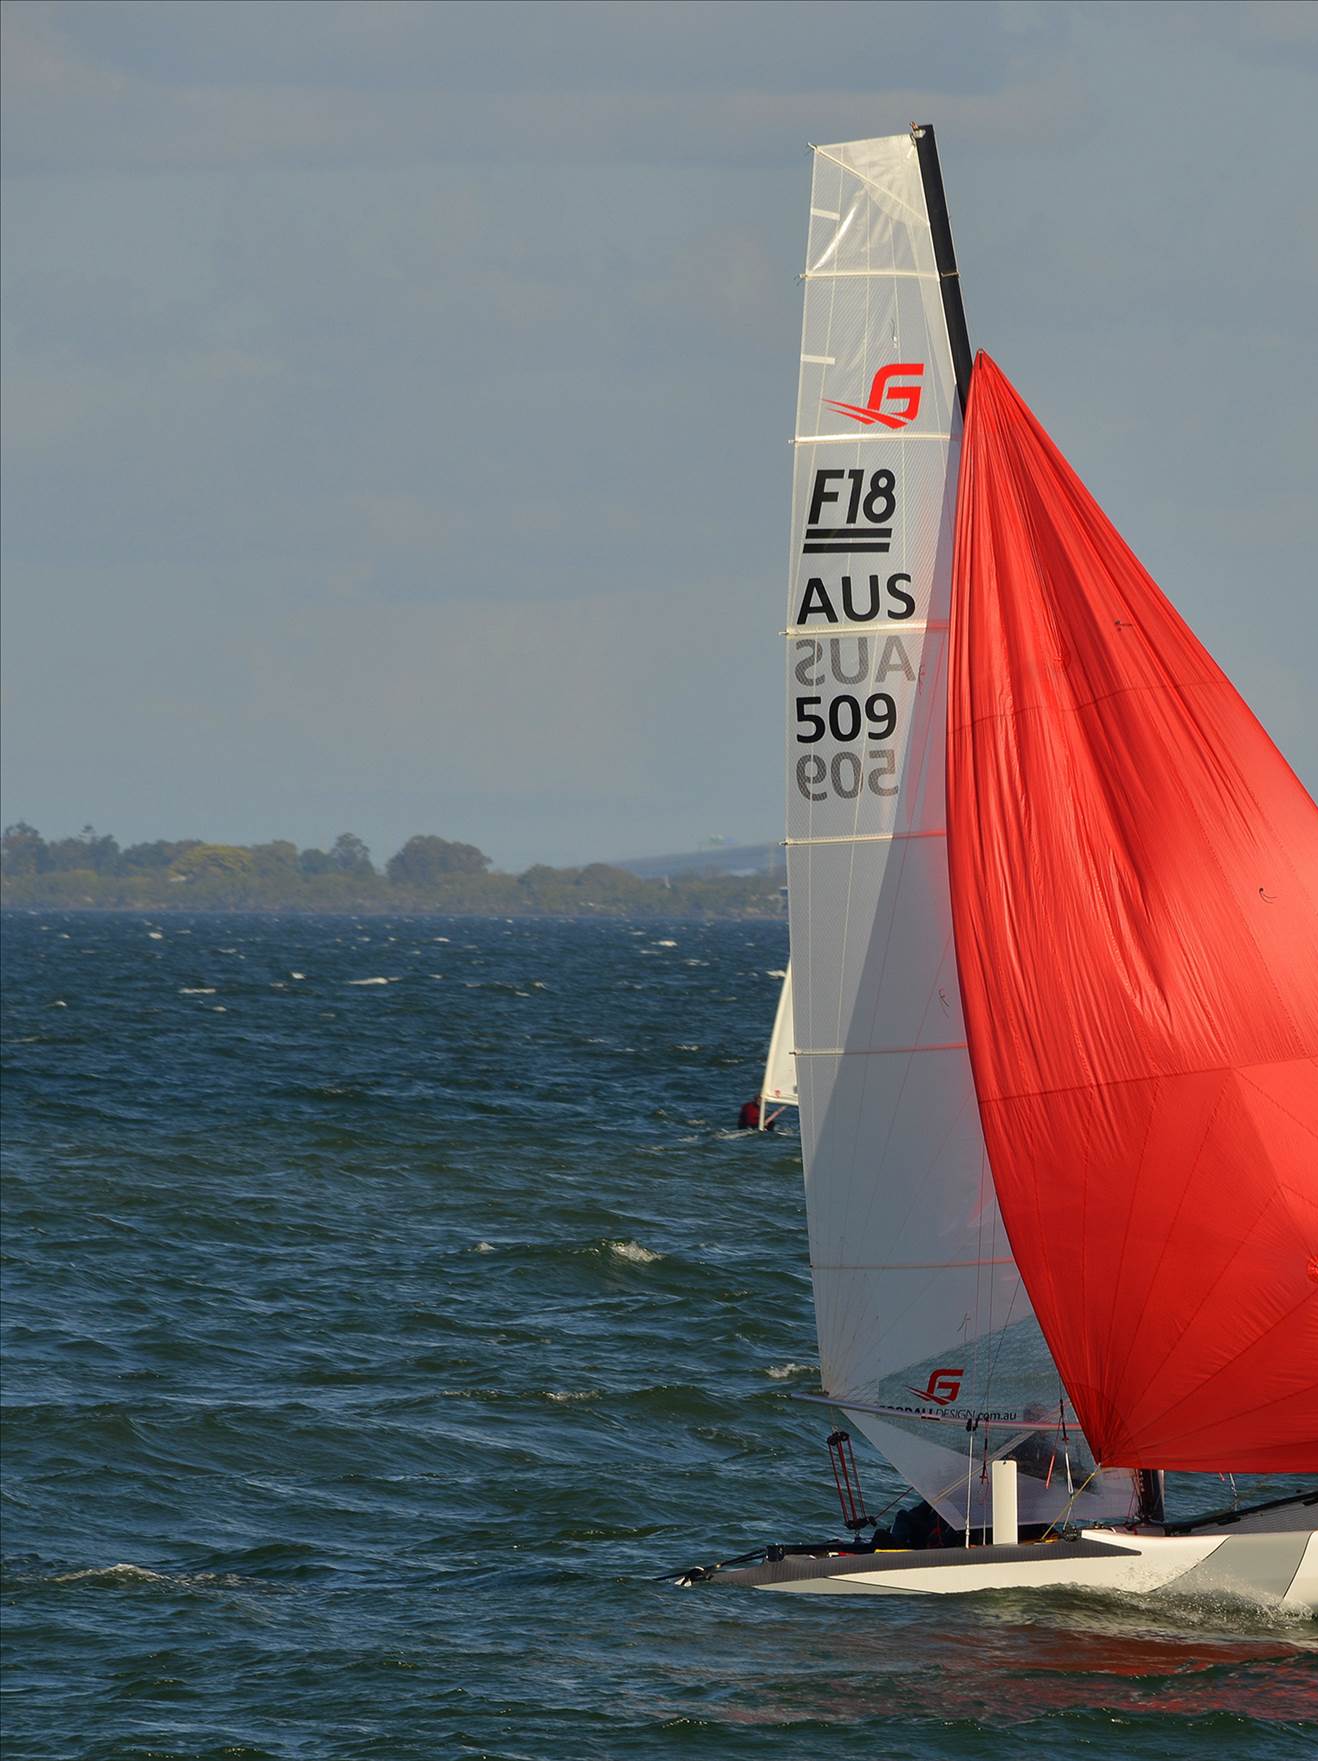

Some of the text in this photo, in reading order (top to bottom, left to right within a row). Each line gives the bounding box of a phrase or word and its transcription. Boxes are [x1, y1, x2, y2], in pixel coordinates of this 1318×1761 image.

[807, 469, 896, 525] F18
[797, 573, 916, 625] AUS
[795, 692, 897, 744] 509
